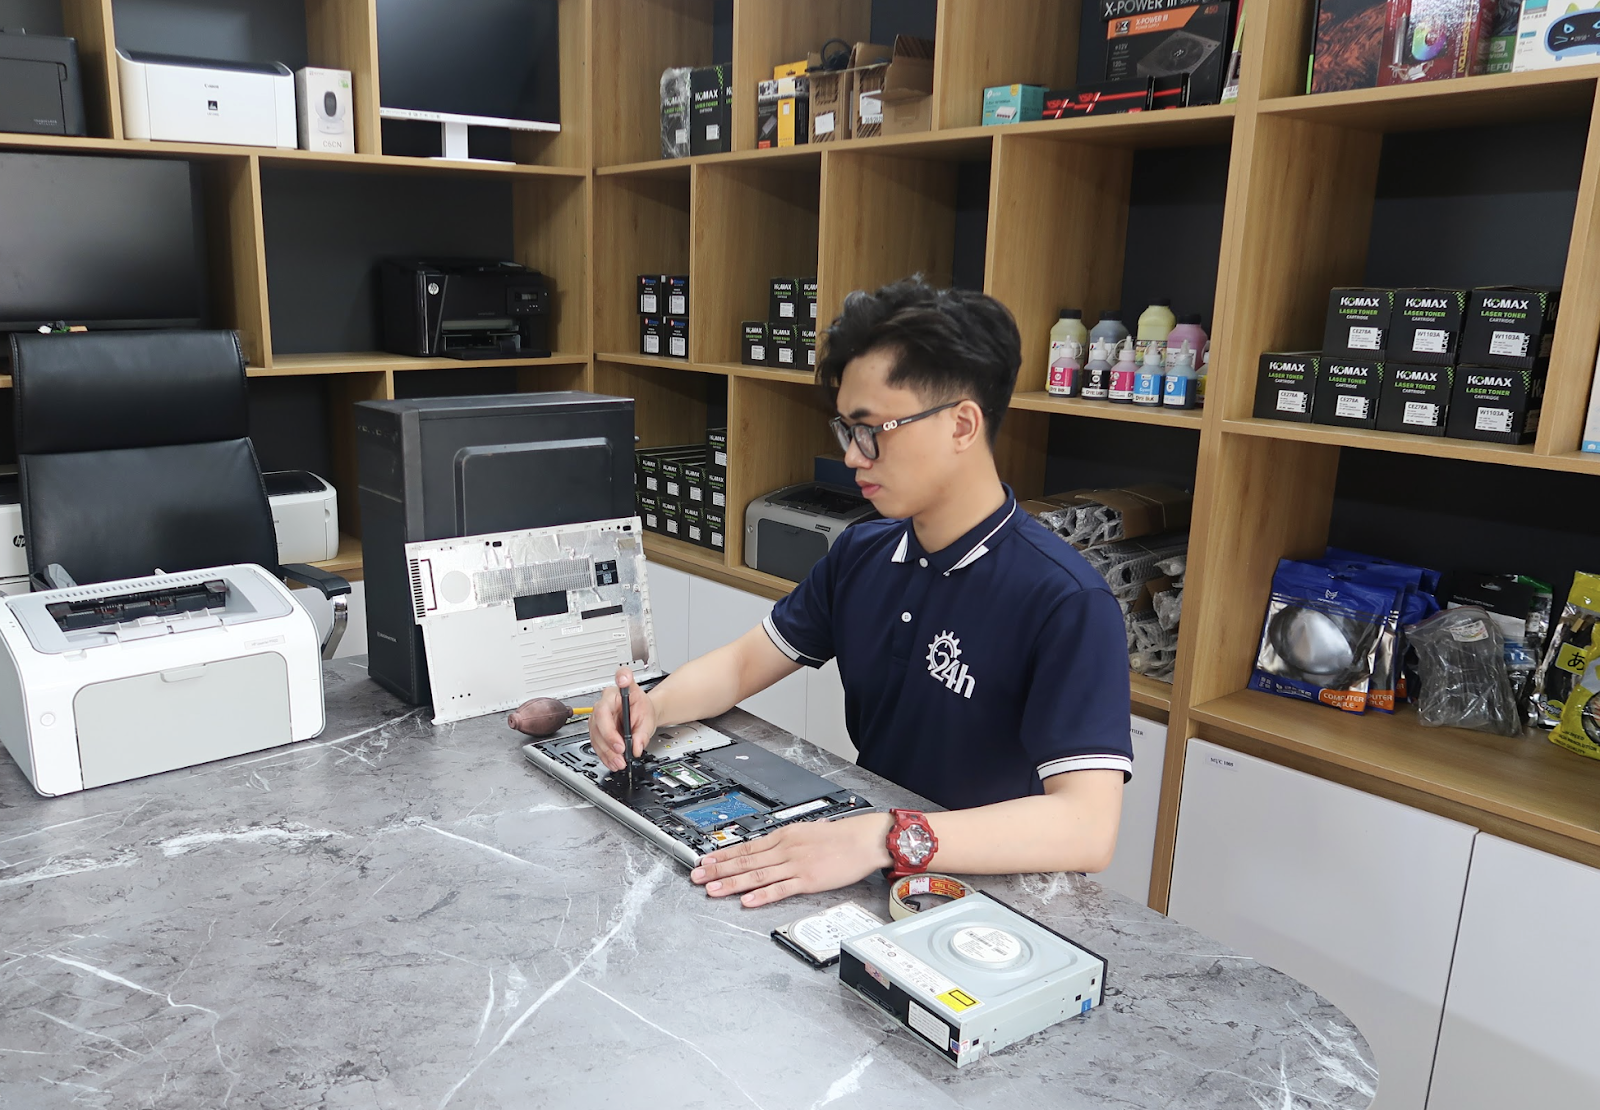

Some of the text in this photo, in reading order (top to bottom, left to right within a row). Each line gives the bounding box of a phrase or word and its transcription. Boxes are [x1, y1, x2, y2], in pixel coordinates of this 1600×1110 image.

[1340, 296, 1380, 307] KOMAX
[1405, 298, 1448, 308] KOMAX
[1483, 298, 1529, 310] KOMAX
[1269, 361, 1305, 372] KOMAX
[1330, 365, 1368, 376] KOMAX
[1396, 370, 1438, 381] KOMAX
[1467, 375, 1512, 387] KOMAX
[930, 651, 976, 699] 24h
[1323, 692, 1364, 702] COMPUTER
